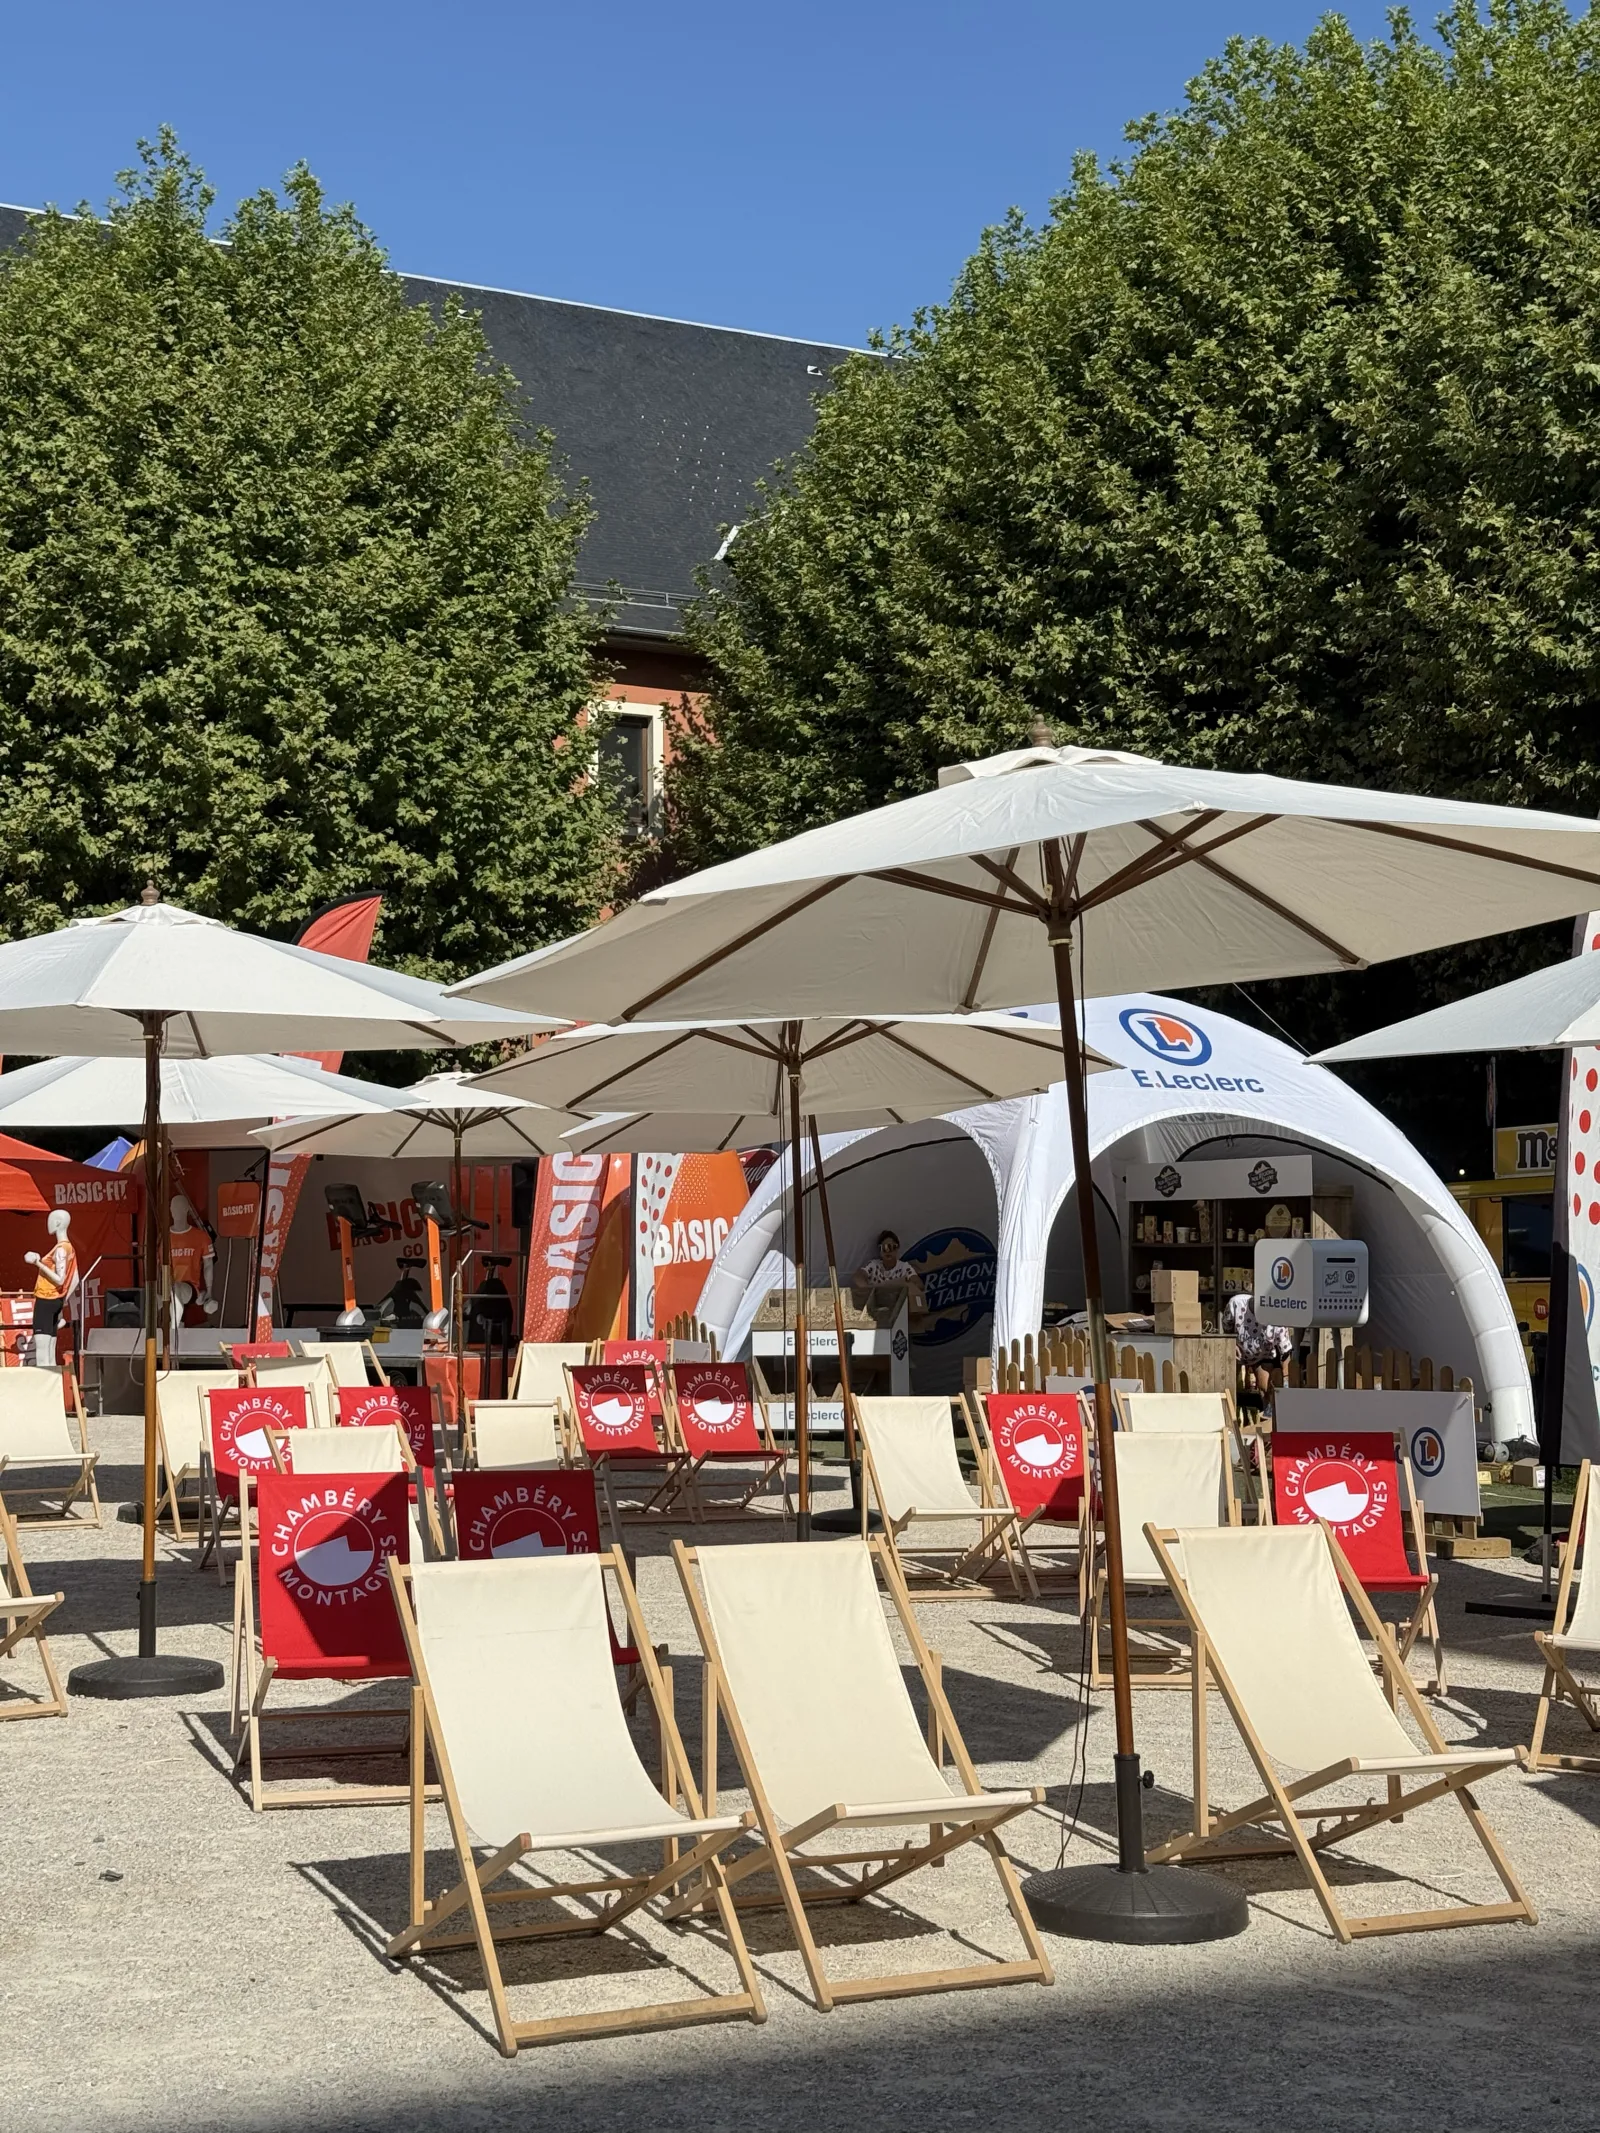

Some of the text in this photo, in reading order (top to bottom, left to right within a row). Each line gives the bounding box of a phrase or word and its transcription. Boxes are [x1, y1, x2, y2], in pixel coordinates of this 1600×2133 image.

[1131, 1069, 1264, 1093] E.Leclerc
[1260, 1296, 1307, 1310] E.Leclerc
[349, 1394, 419, 1427] HAMBÉRY
[580, 1371, 638, 1409] CHAMBÉRY
[682, 1370, 739, 1407] CHAMBÉRY
[220, 1395, 293, 1440] CHAMBÉRY
[585, 1396, 645, 1437] MONTAGNES
[687, 1393, 746, 1434] MONTAGNES
[1000, 1403, 1068, 1447] CHAMBÉRY
[1007, 1433, 1077, 1479] MONTAGNES
[1285, 1443, 1378, 1497] CHAMBÉRY
[271, 1487, 388, 1556] CHAMBÉRY
[469, 1484, 578, 1551] CHAMBÉRY
[1292, 1480, 1388, 1537] MTAGNES
[278, 1535, 397, 1606] MONTAGNES
